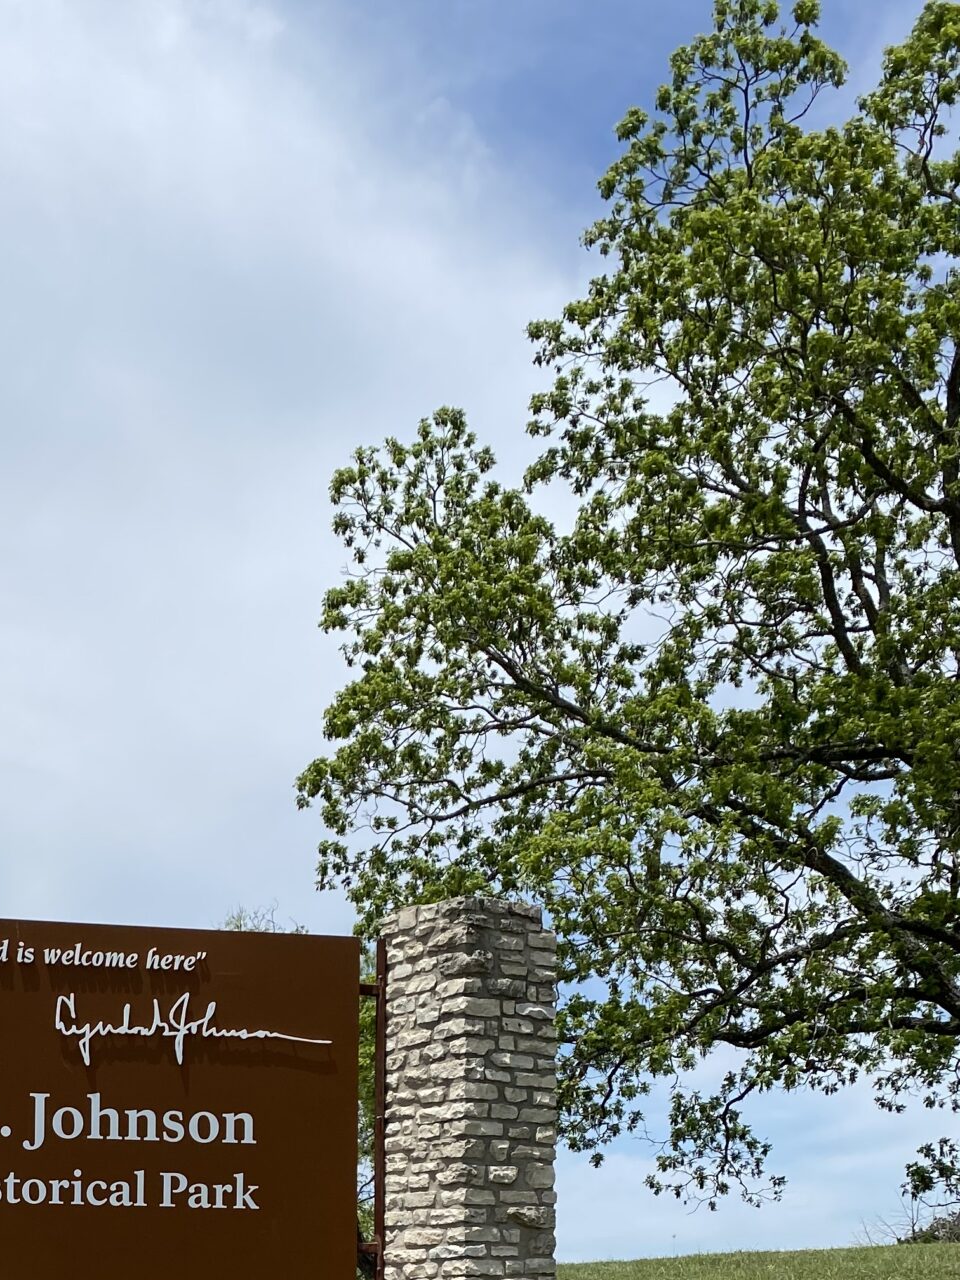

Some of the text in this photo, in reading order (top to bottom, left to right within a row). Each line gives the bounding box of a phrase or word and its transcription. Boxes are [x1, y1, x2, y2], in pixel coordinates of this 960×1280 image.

[16, 941, 35, 964] is
[43, 947, 139, 970] welcome
[23, 1092, 257, 1151] Johnson
[159, 1172, 260, 1210] Park
